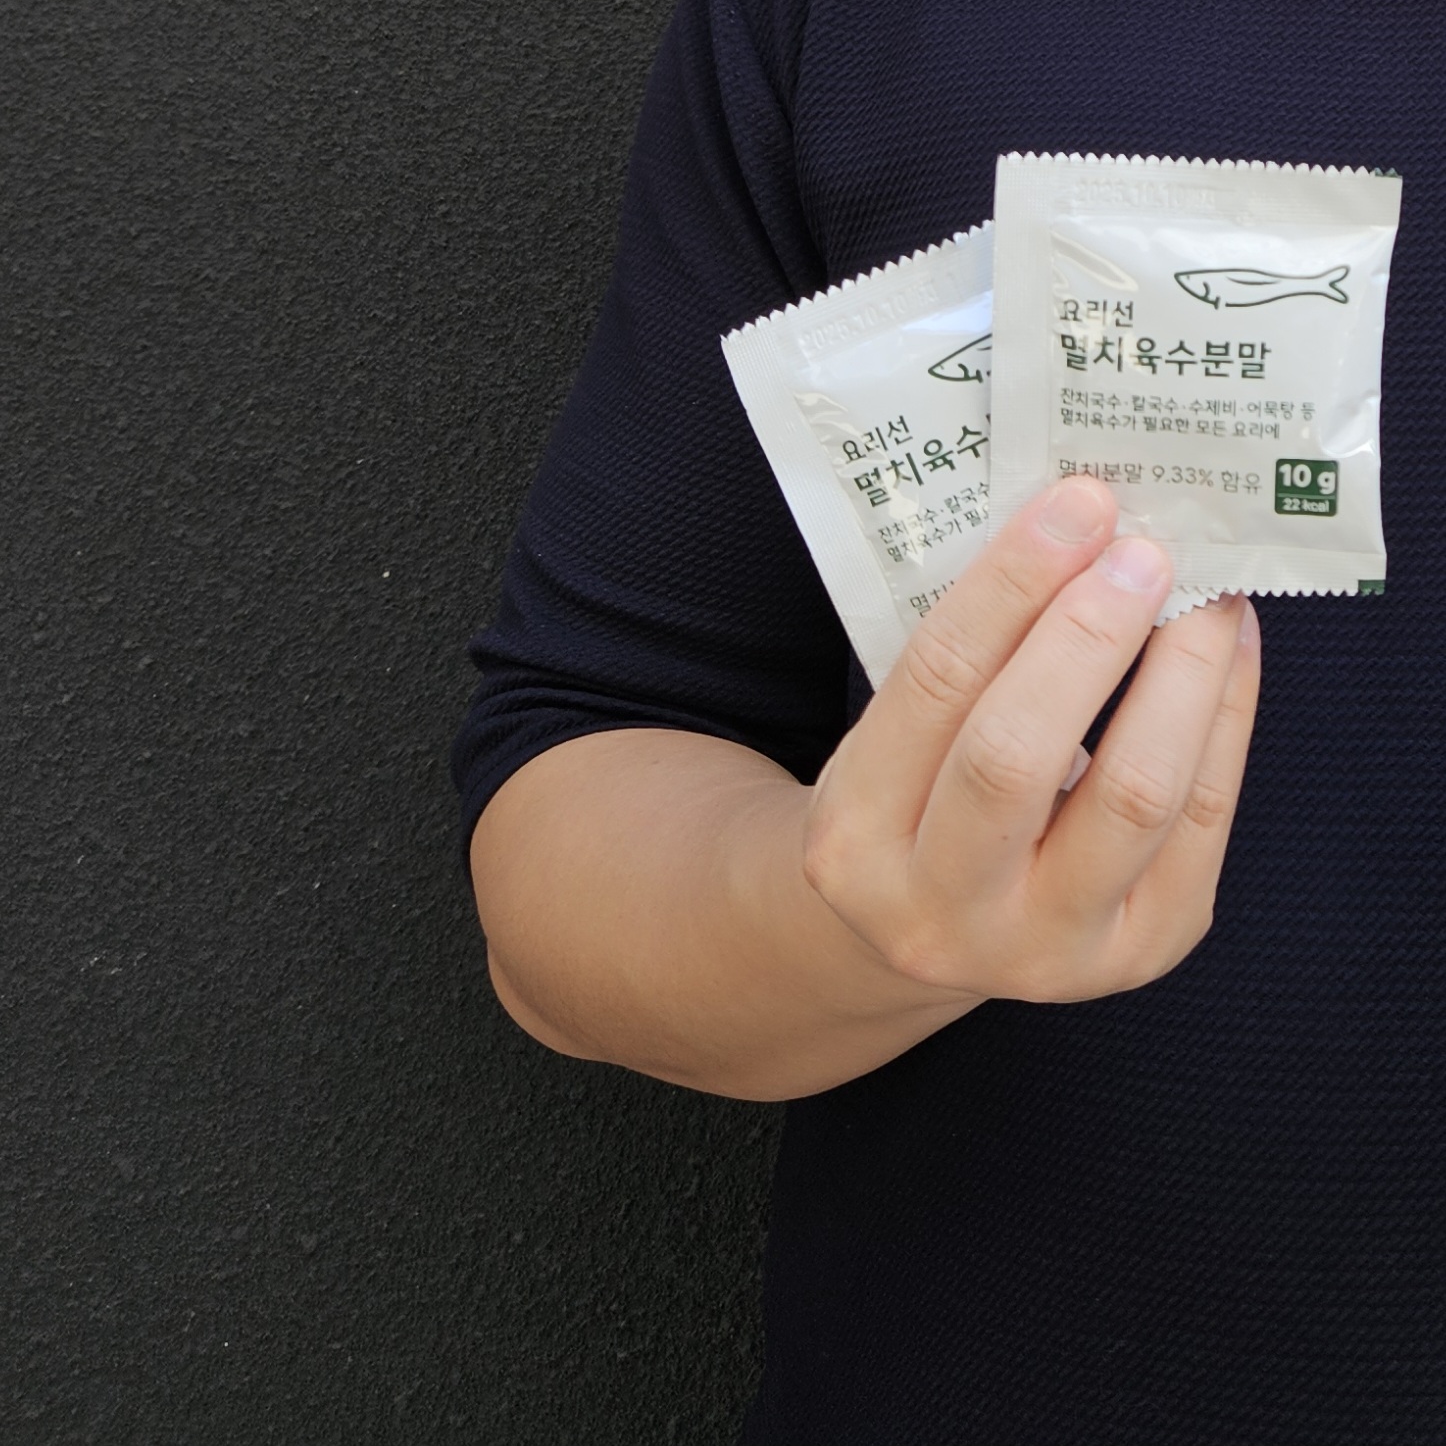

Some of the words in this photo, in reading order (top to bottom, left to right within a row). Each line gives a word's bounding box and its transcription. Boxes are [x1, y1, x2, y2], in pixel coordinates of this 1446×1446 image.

[1060, 300, 1134, 328] 요리선
[1060, 333, 1271, 379] 멸치육수분말
[1061, 408, 1138, 430] 멸치육수가
[1142, 416, 1190, 434] 필요한
[1196, 420, 1227, 436] 모든
[1232, 422, 1280, 440] 요리에
[1301, 405, 1316, 422] 등
[842, 415, 913, 465] 요리선
[854, 413, 990, 507] 멸치육수
[1060, 459, 1145, 484] 멸치분말
[1152, 465, 1214, 488] 9.33%
[1221, 471, 1262, 494] 함유
[1279, 463, 1312, 488] 10
[887, 518, 962, 562] 멸치육수가
[910, 580, 954, 618] 멸치
